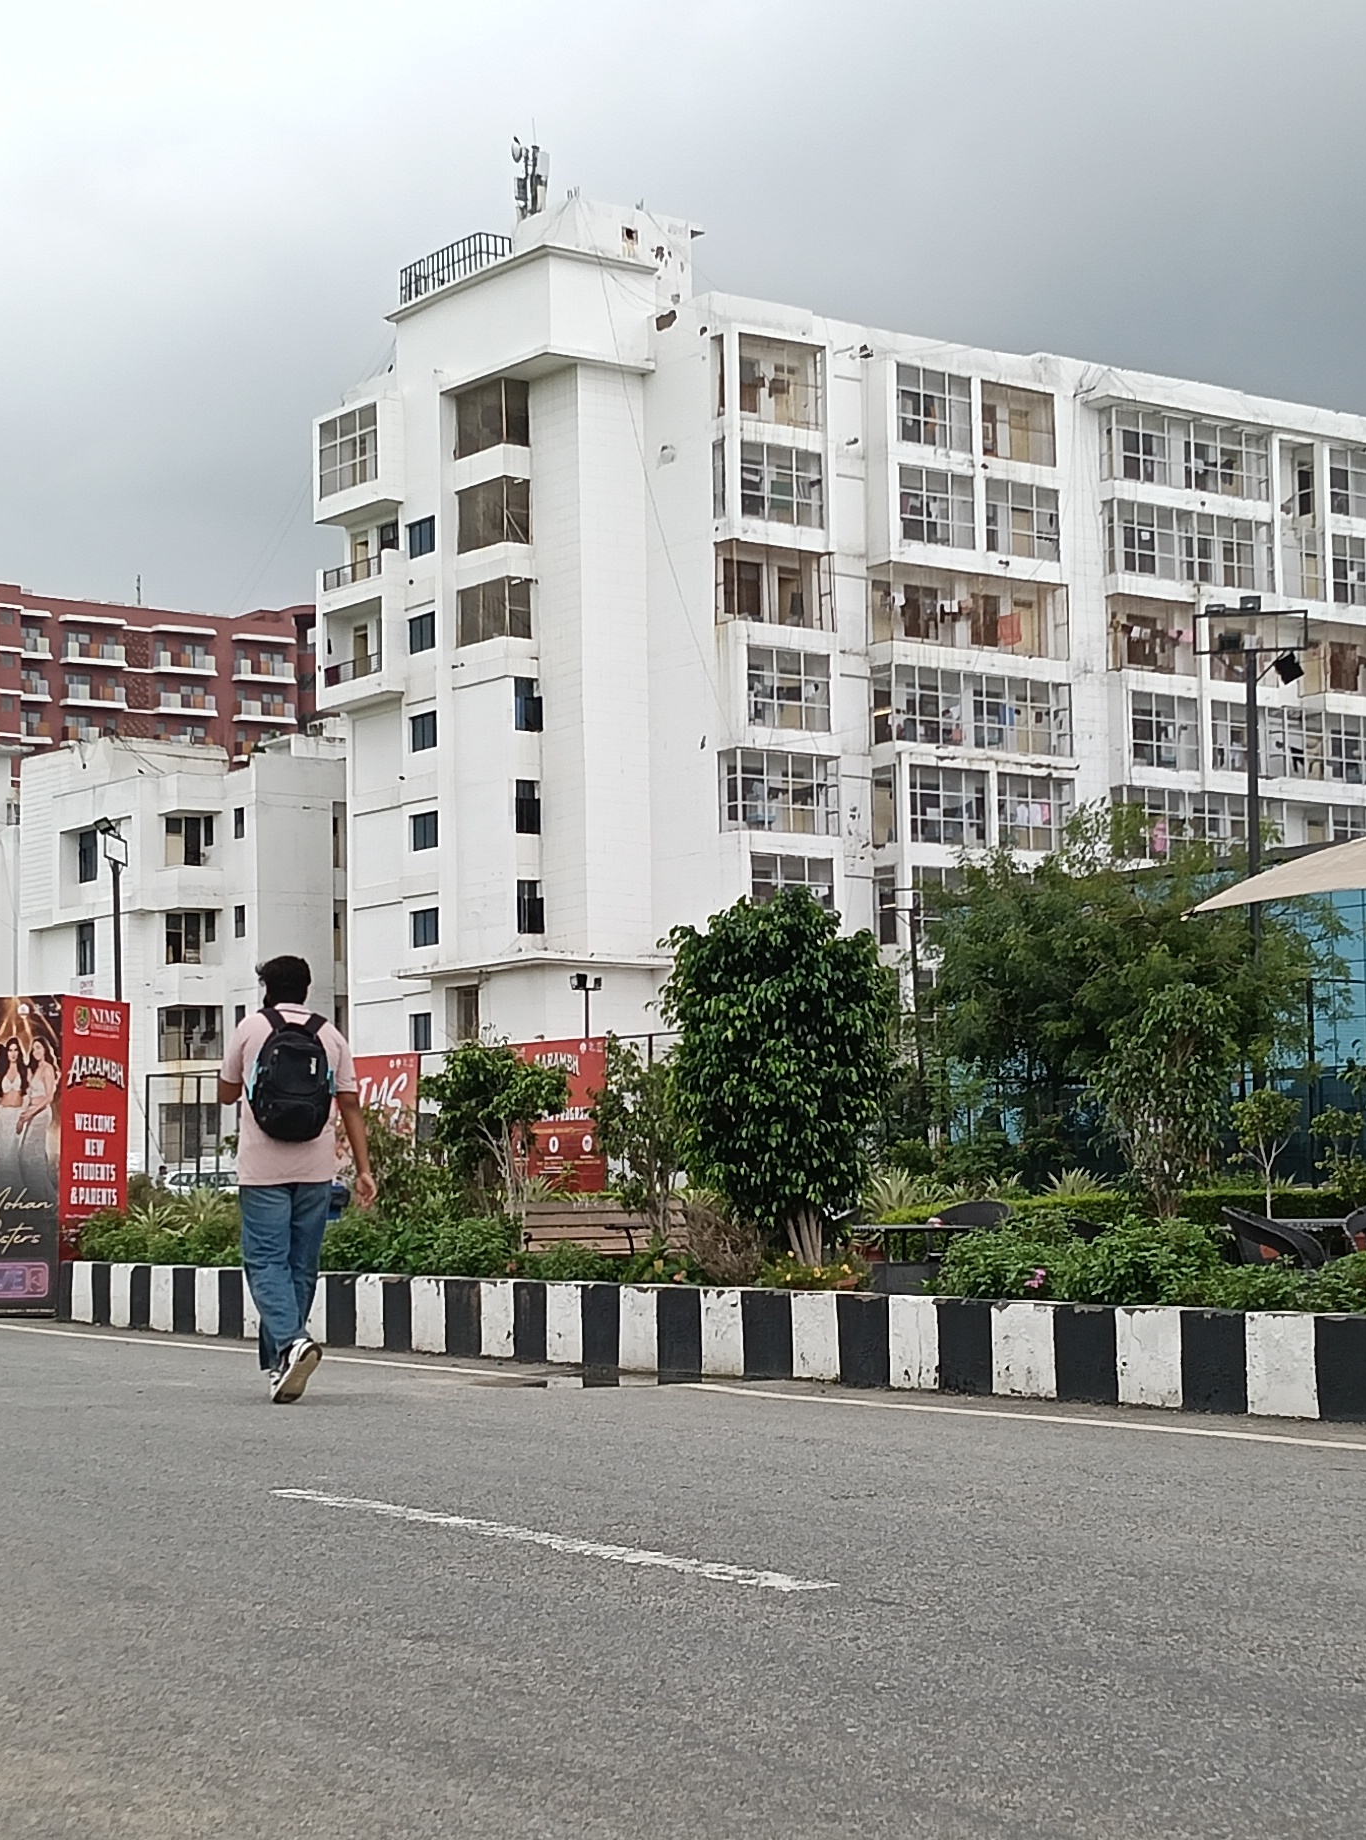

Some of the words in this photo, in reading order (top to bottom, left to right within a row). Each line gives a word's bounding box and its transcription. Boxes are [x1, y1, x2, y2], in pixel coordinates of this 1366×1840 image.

[91, 1007, 121, 1026] NIMS
[66, 1055, 125, 1089] AARAMBH
[74, 1112, 116, 1133] WELCOME
[84, 1138, 105, 1156] NEW
[72, 1162, 116, 1181] STUDENTS
